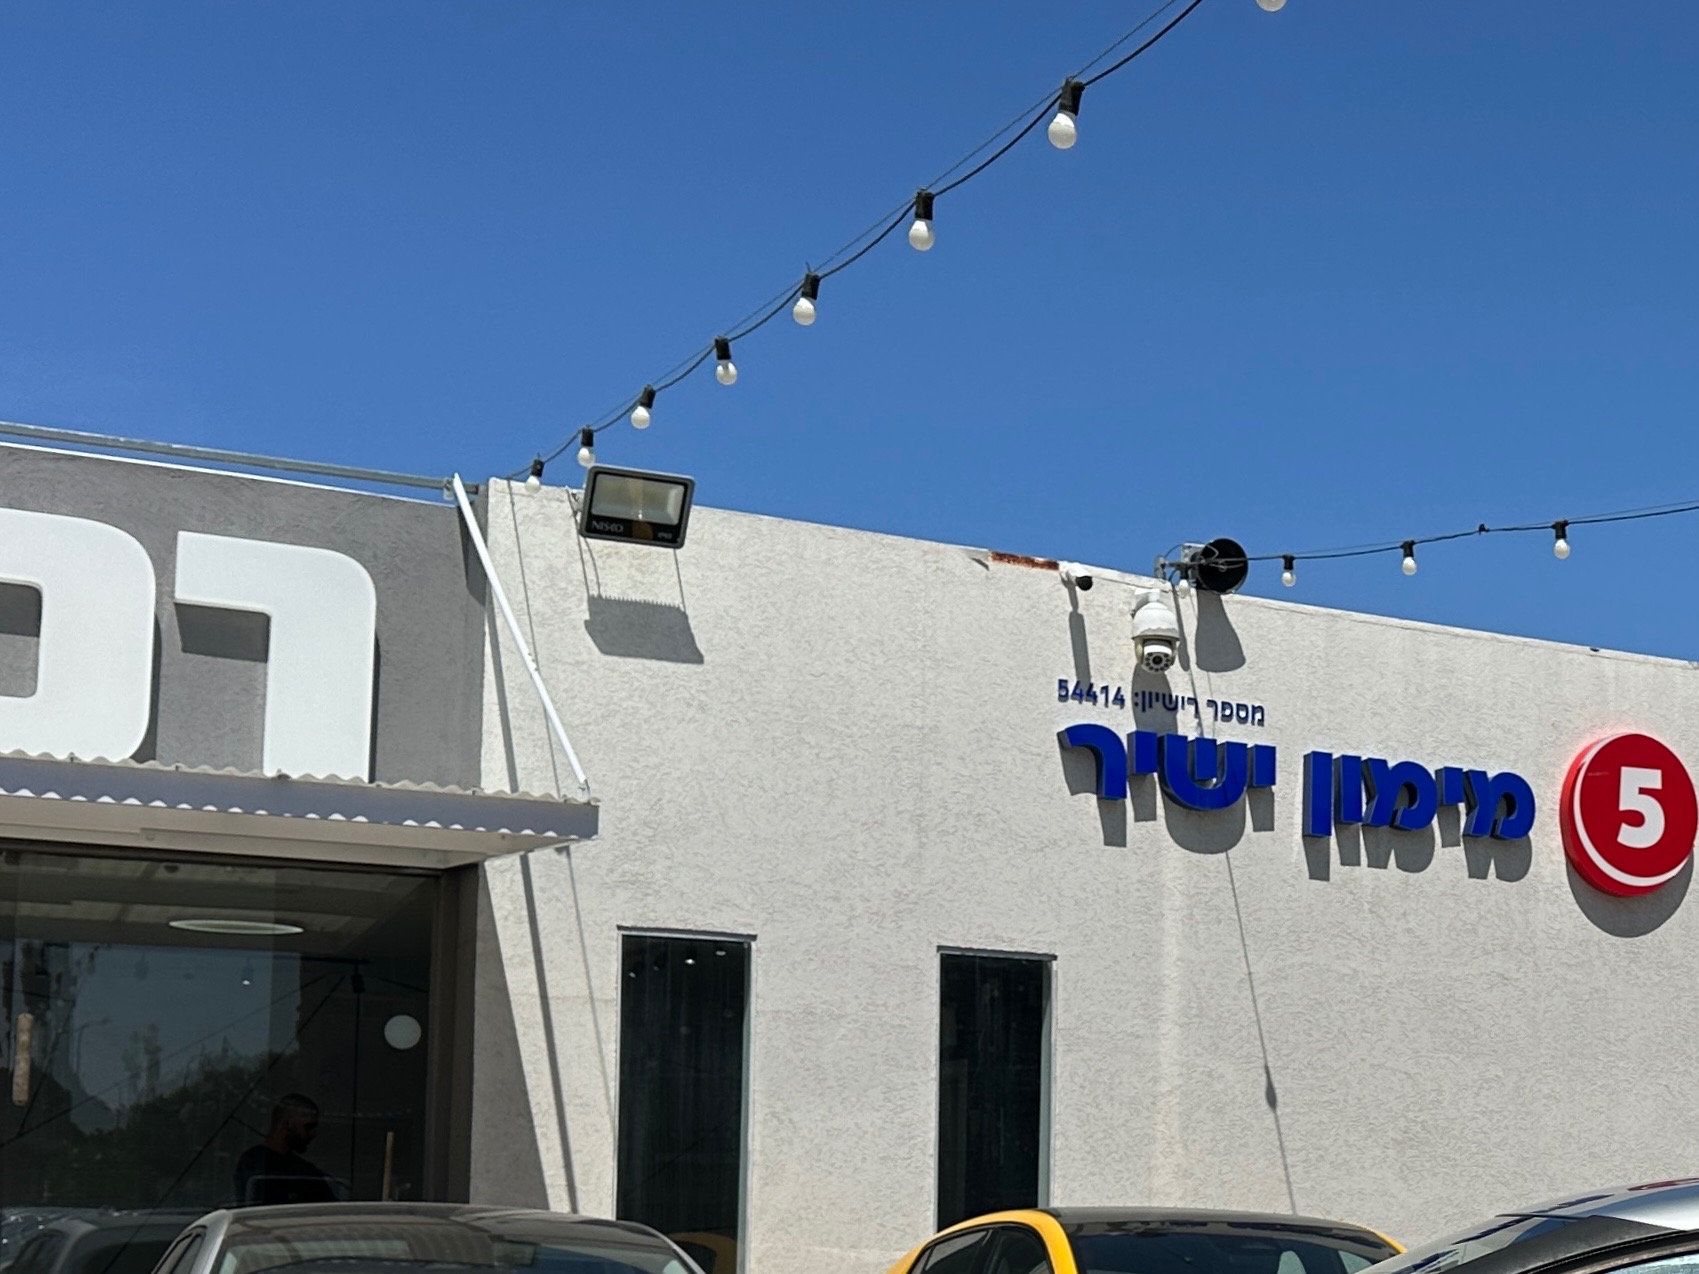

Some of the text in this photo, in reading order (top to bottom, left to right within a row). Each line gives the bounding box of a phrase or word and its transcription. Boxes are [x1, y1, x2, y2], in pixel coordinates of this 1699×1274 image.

[1057, 679, 1126, 710] 54414
[1206, 698, 1265, 727] מספר
[1056, 723, 1536, 840] מימון ישיר
[1616, 765, 1665, 849] 5
